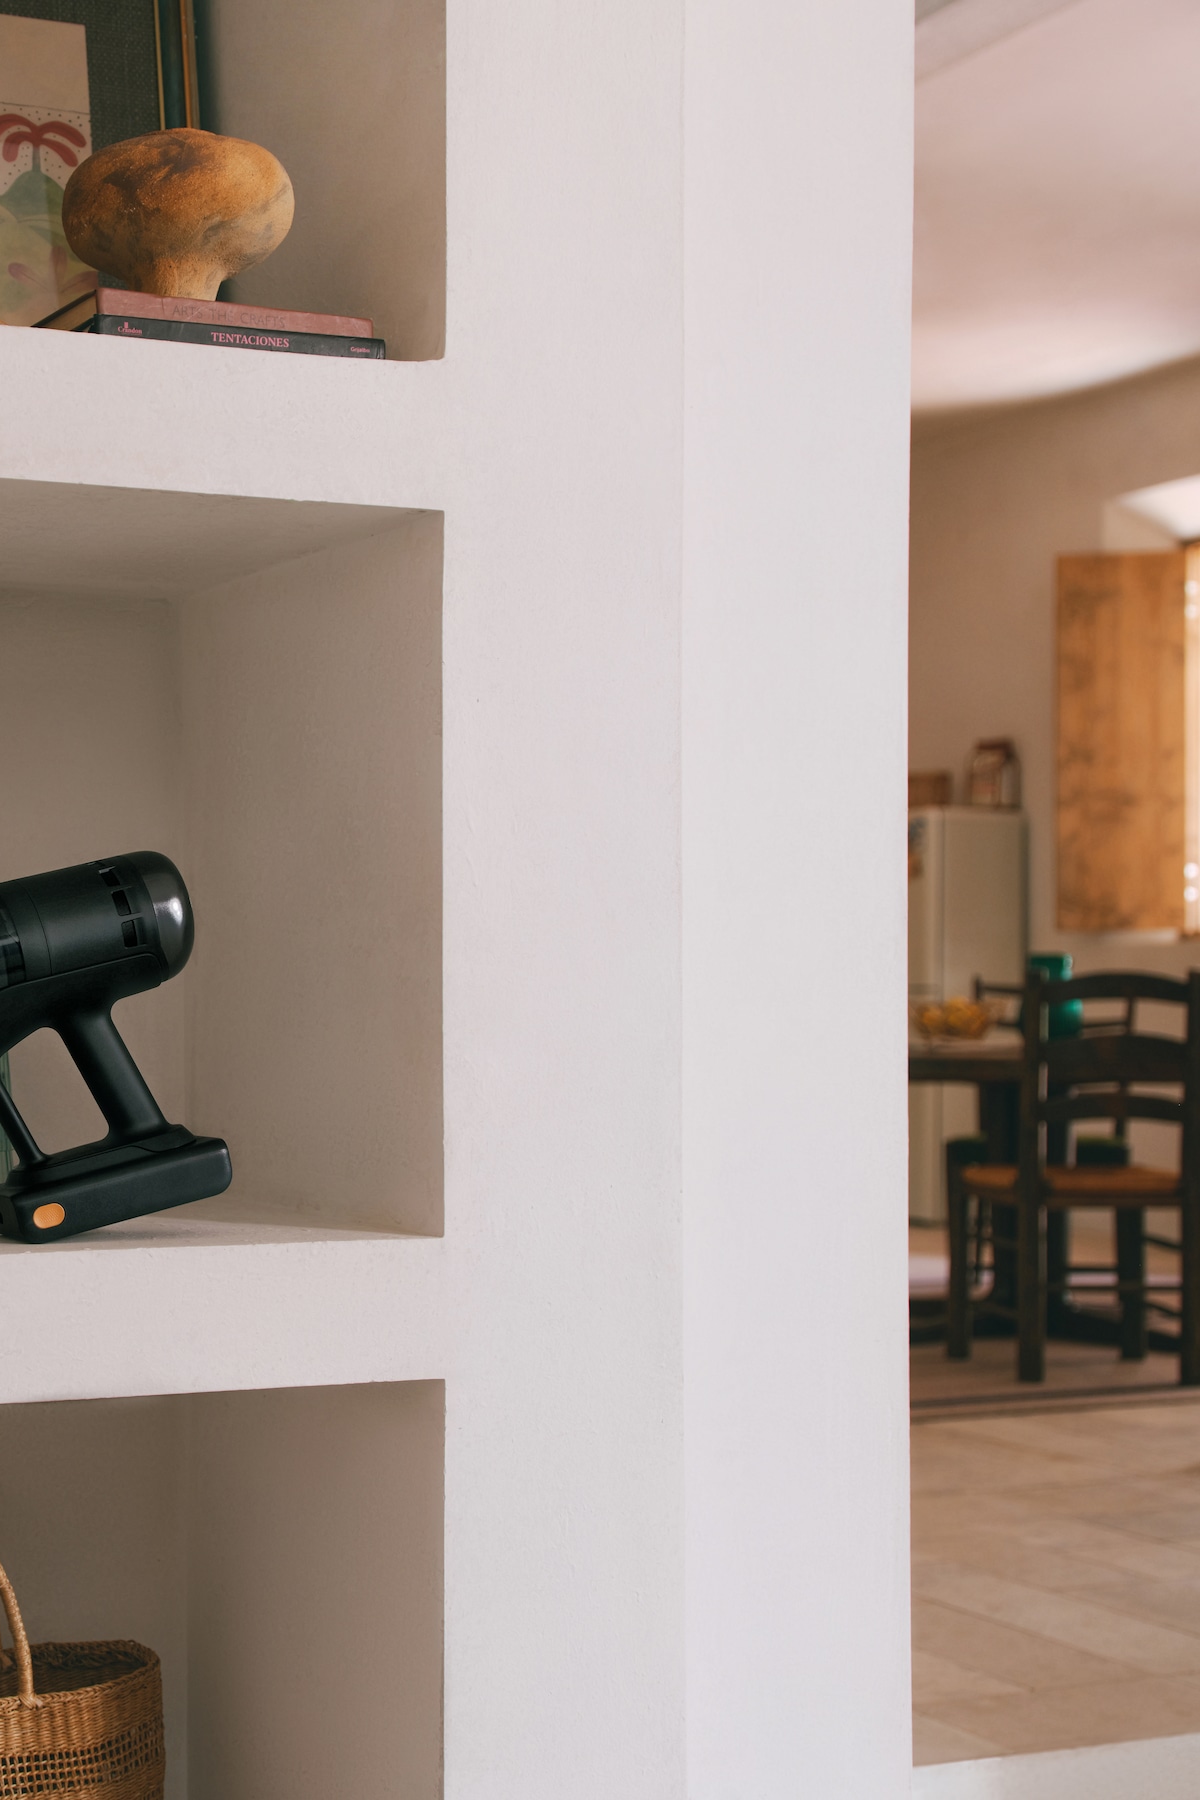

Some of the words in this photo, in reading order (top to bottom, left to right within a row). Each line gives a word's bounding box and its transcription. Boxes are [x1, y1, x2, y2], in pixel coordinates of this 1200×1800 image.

[172, 304, 203, 320] ARTS
[208, 308, 234, 322] THE
[239, 312, 286, 329] CRAFTS
[211, 332, 290, 348] TENTACIONES
